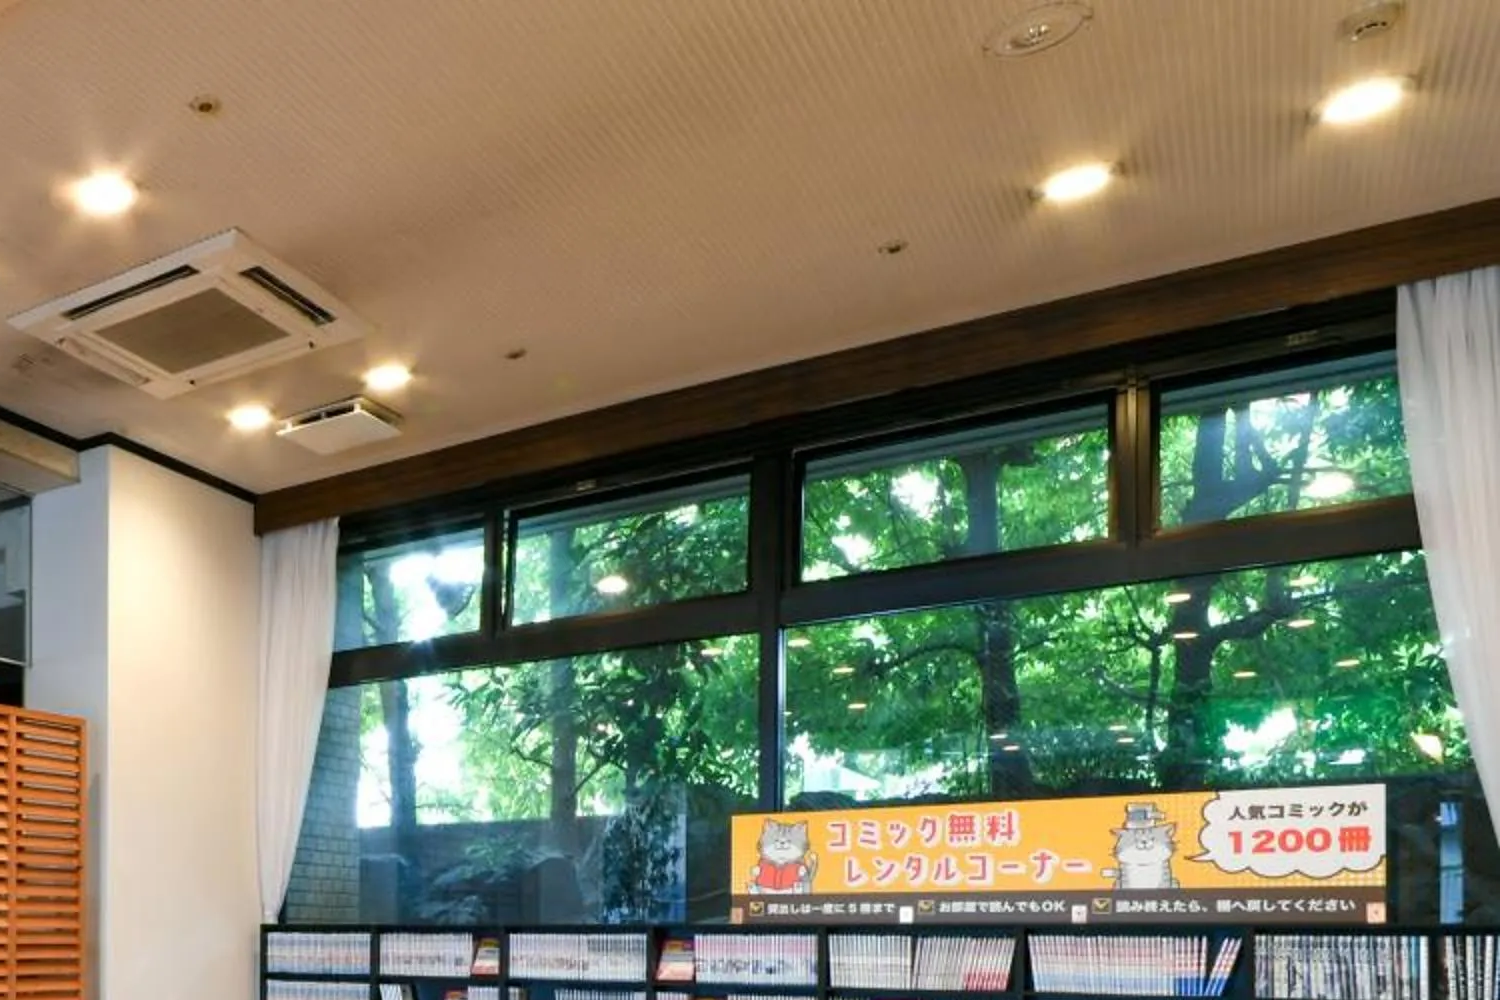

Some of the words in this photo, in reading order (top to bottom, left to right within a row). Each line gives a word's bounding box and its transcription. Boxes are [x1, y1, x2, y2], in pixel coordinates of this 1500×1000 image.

[1227, 801, 1368, 821] 人気コミックが
[828, 811, 1015, 848] コミック無料
[1227, 825, 1372, 854] 1200冊
[846, 851, 1086, 883] レンタルコーナー
